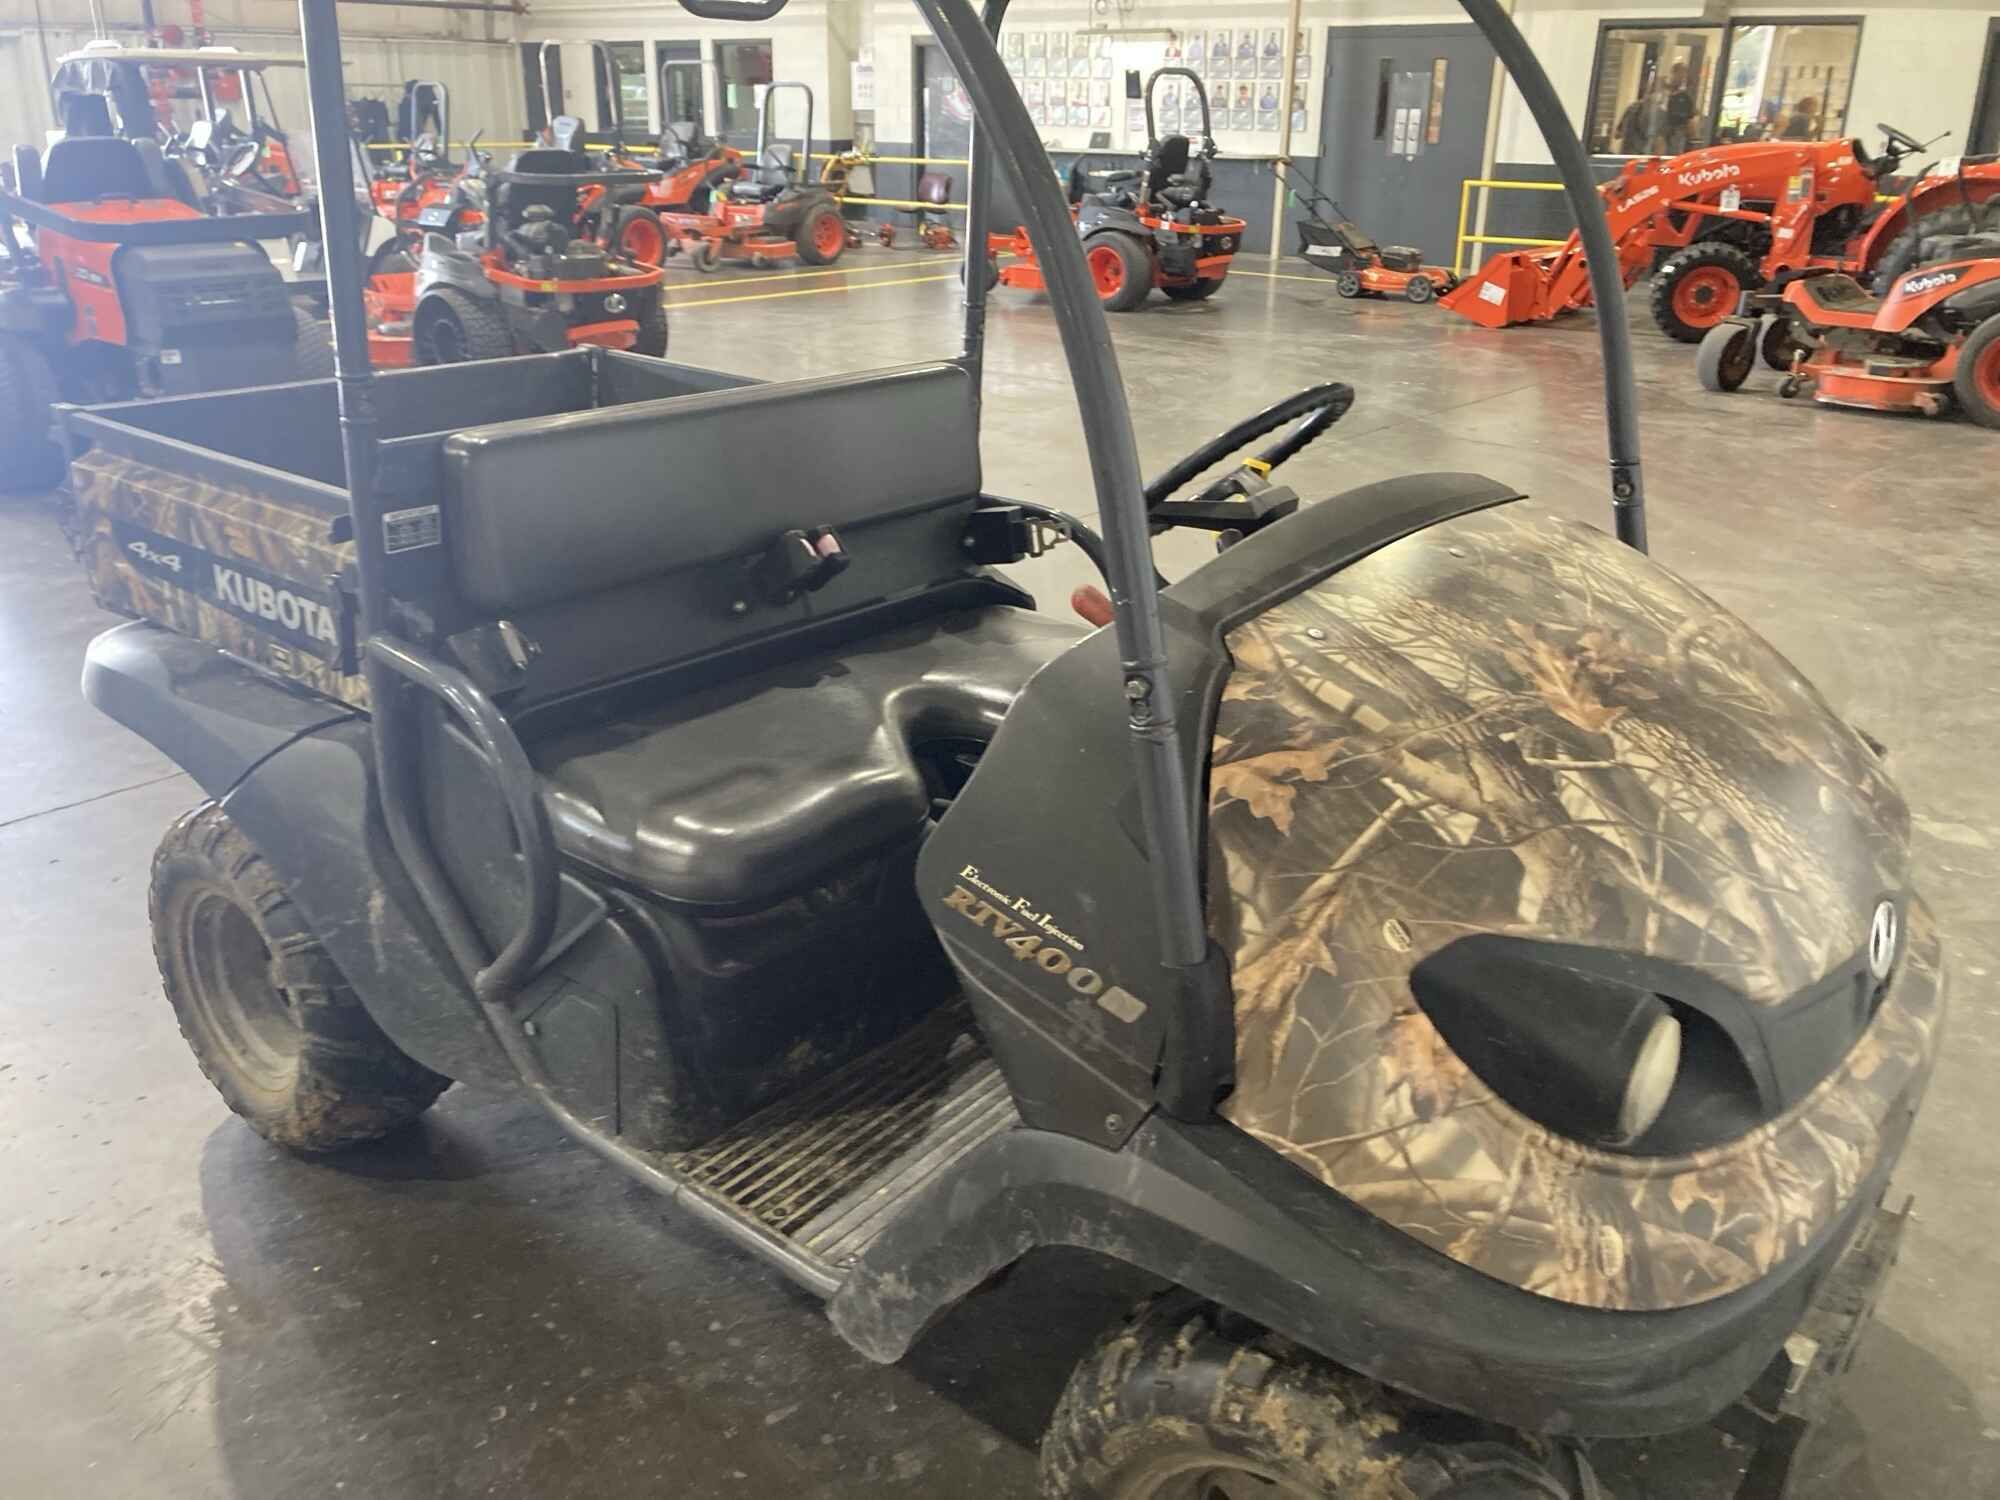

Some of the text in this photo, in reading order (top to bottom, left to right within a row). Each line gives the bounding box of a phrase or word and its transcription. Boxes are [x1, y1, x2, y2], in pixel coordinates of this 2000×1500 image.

[1678, 164, 1740, 186] Kubota
[1904, 273, 1956, 292] Kubota
[128, 541, 183, 573] 4x4
[212, 563, 339, 647] KUBOTA
[1011, 897, 1040, 921] Fuel
[942, 884, 1103, 994] RTV400
